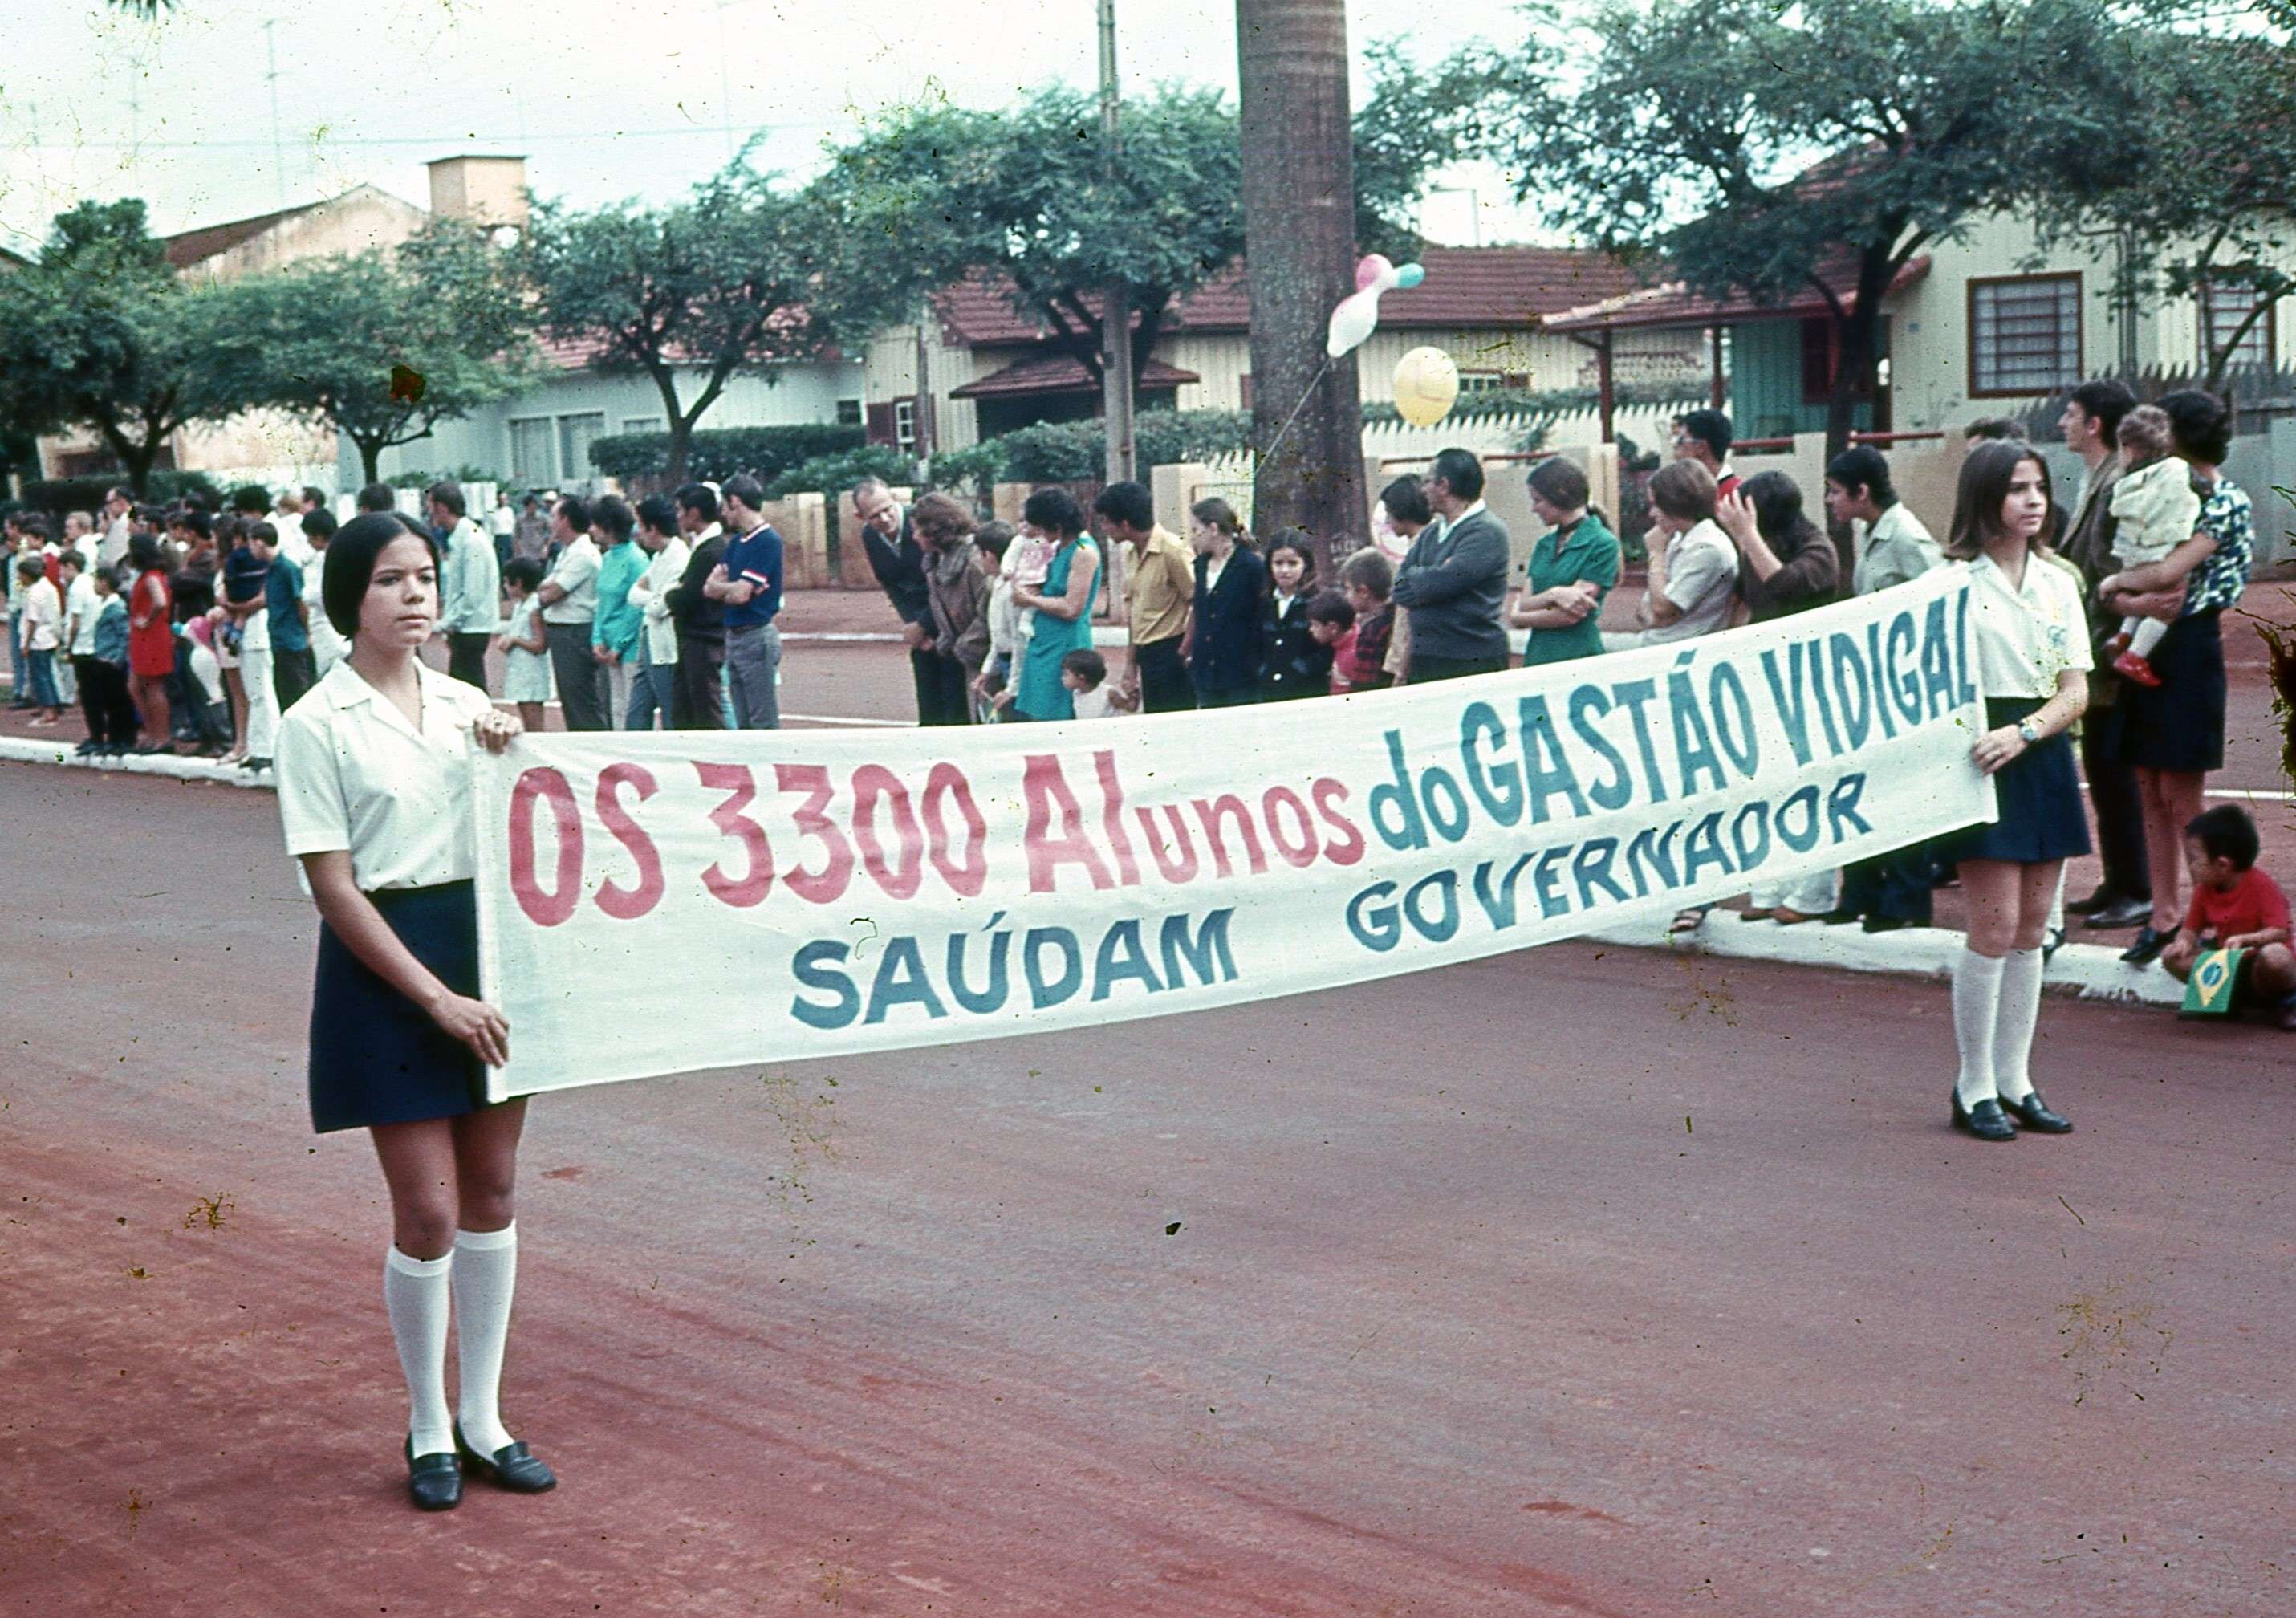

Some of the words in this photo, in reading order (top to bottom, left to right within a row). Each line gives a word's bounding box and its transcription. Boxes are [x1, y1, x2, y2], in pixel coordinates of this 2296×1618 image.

[508, 762, 666, 926] OS
[690, 762, 988, 909] 3300
[1022, 749, 1366, 893] Alunos
[1758, 586, 1977, 766] VIDIGAL
[790, 909, 1239, 1030] SAÚDAM
[1344, 769, 1872, 952] GOVERNADOR
